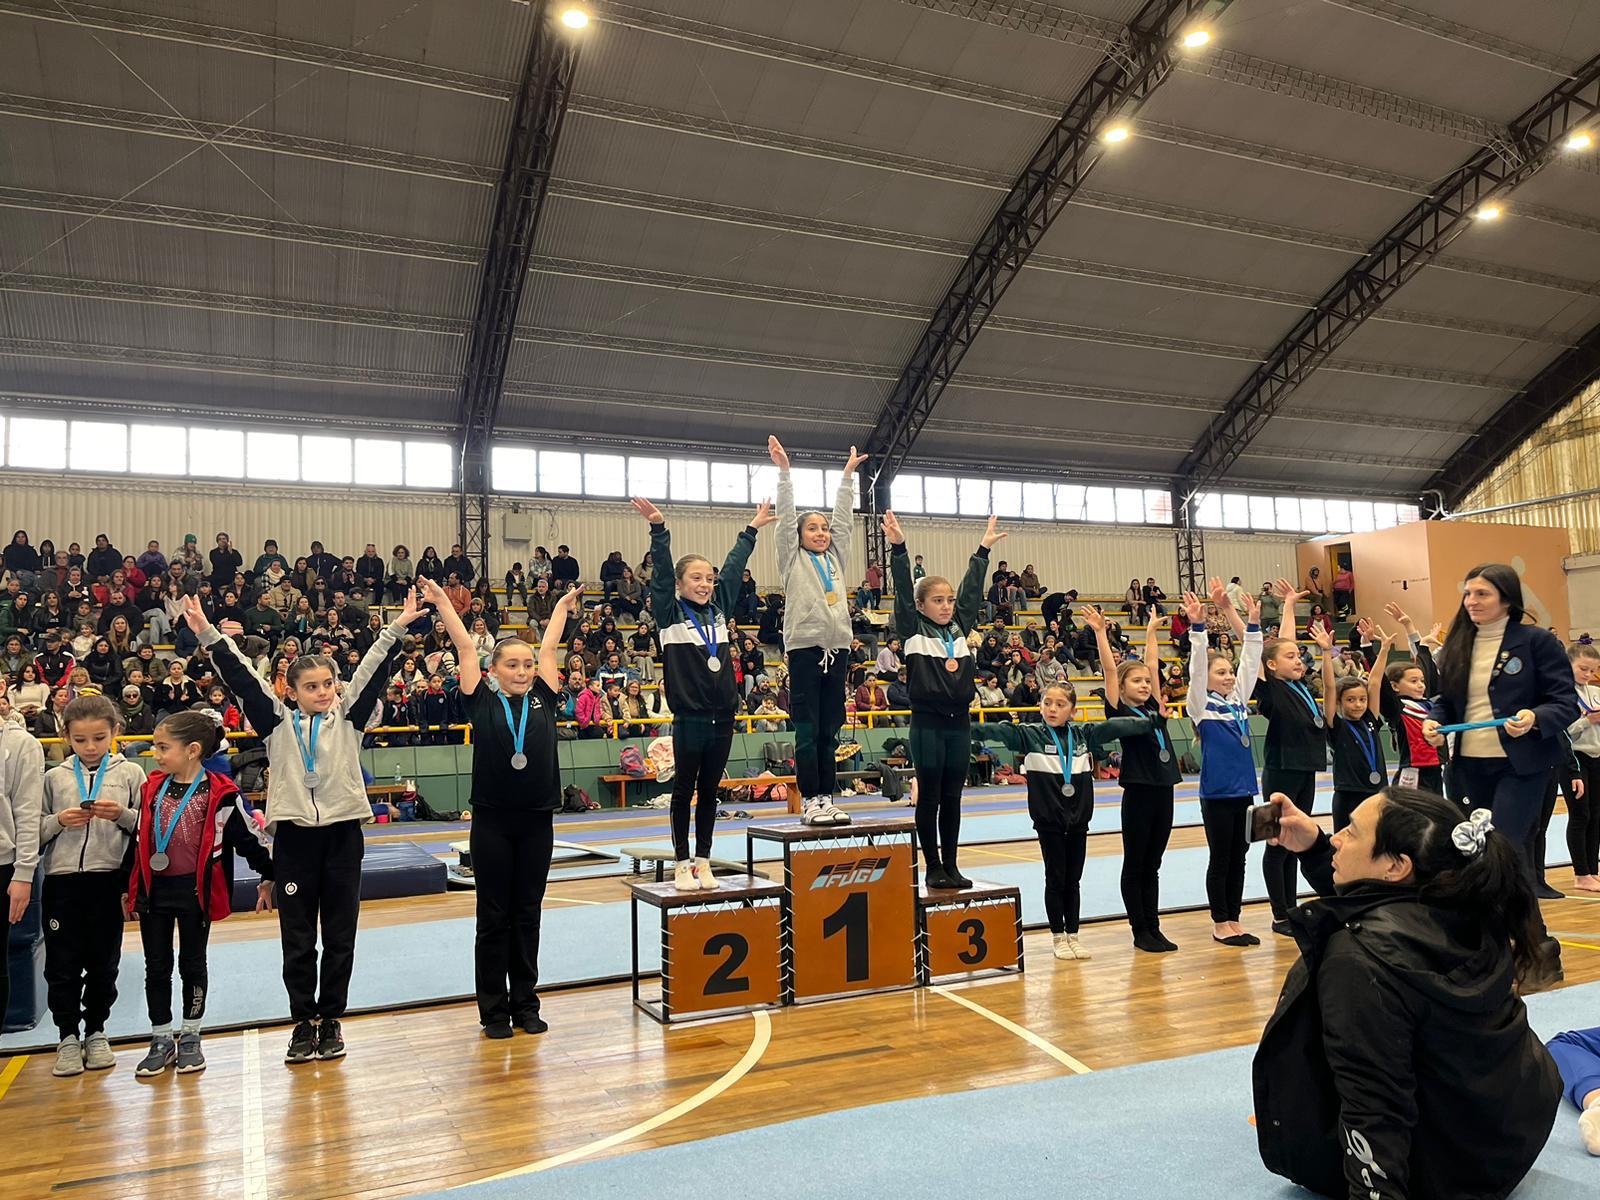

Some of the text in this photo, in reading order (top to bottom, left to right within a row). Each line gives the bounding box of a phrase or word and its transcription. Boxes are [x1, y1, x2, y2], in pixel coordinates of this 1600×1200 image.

[702, 933, 750, 996] 2
[823, 892, 870, 983] 1
[957, 919, 988, 965] 3
